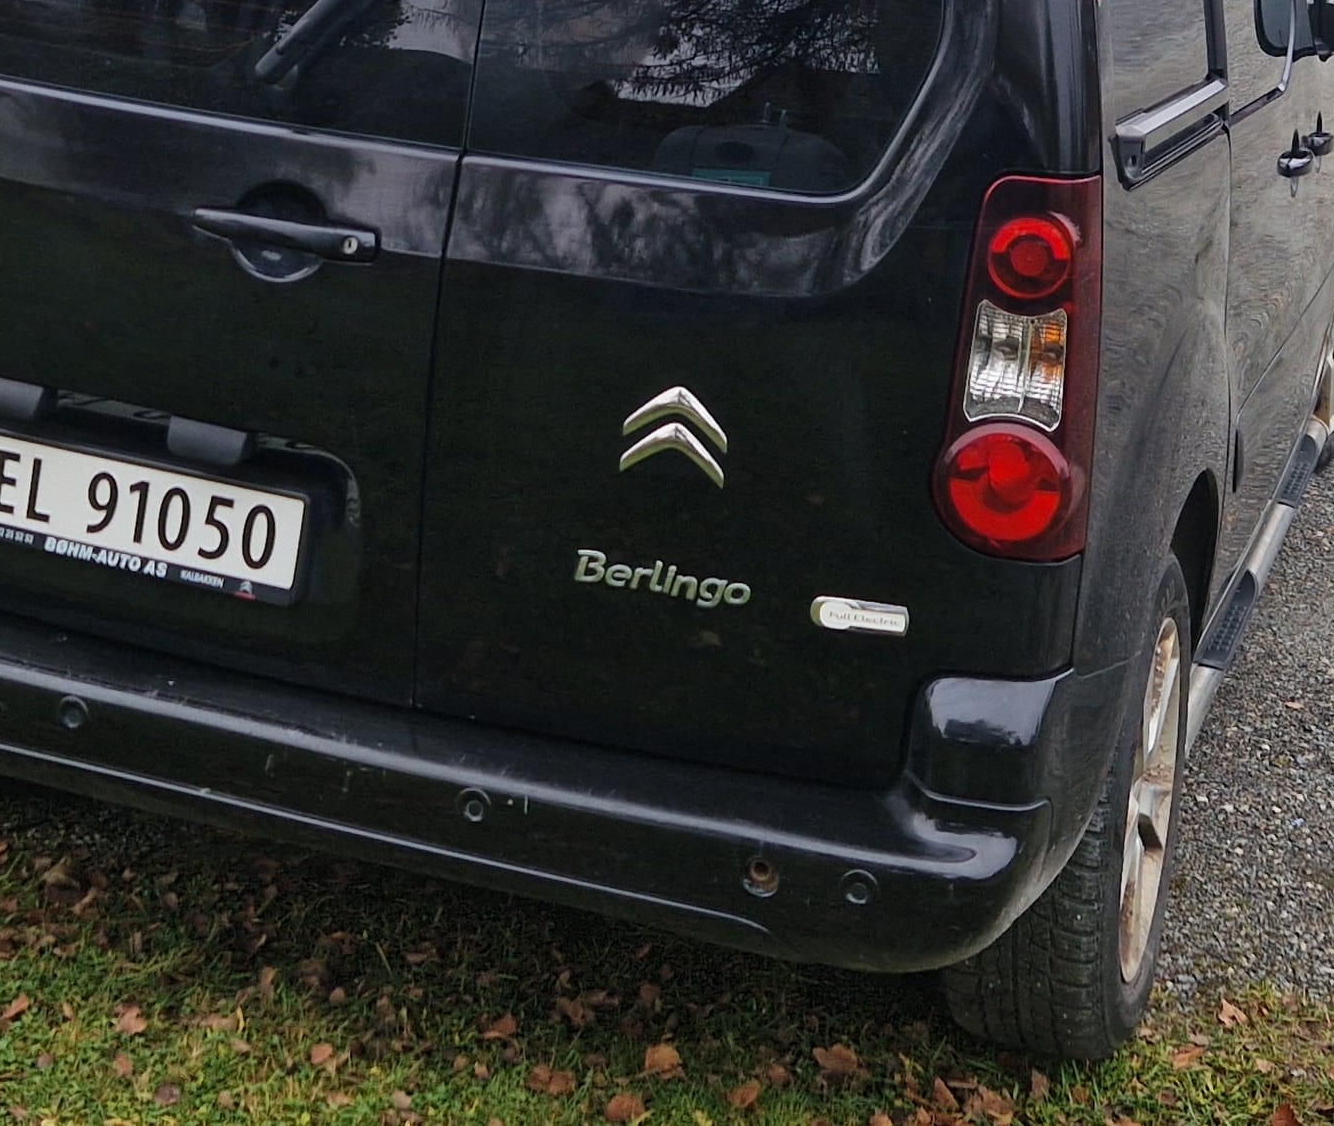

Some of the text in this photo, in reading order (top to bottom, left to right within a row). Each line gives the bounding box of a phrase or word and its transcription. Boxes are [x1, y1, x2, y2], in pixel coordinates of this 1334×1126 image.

[86, 471, 276, 570] 91050
[43, 536, 168, 578] BØHM-AUTO AS
[573, 548, 752, 609] Berlingo
